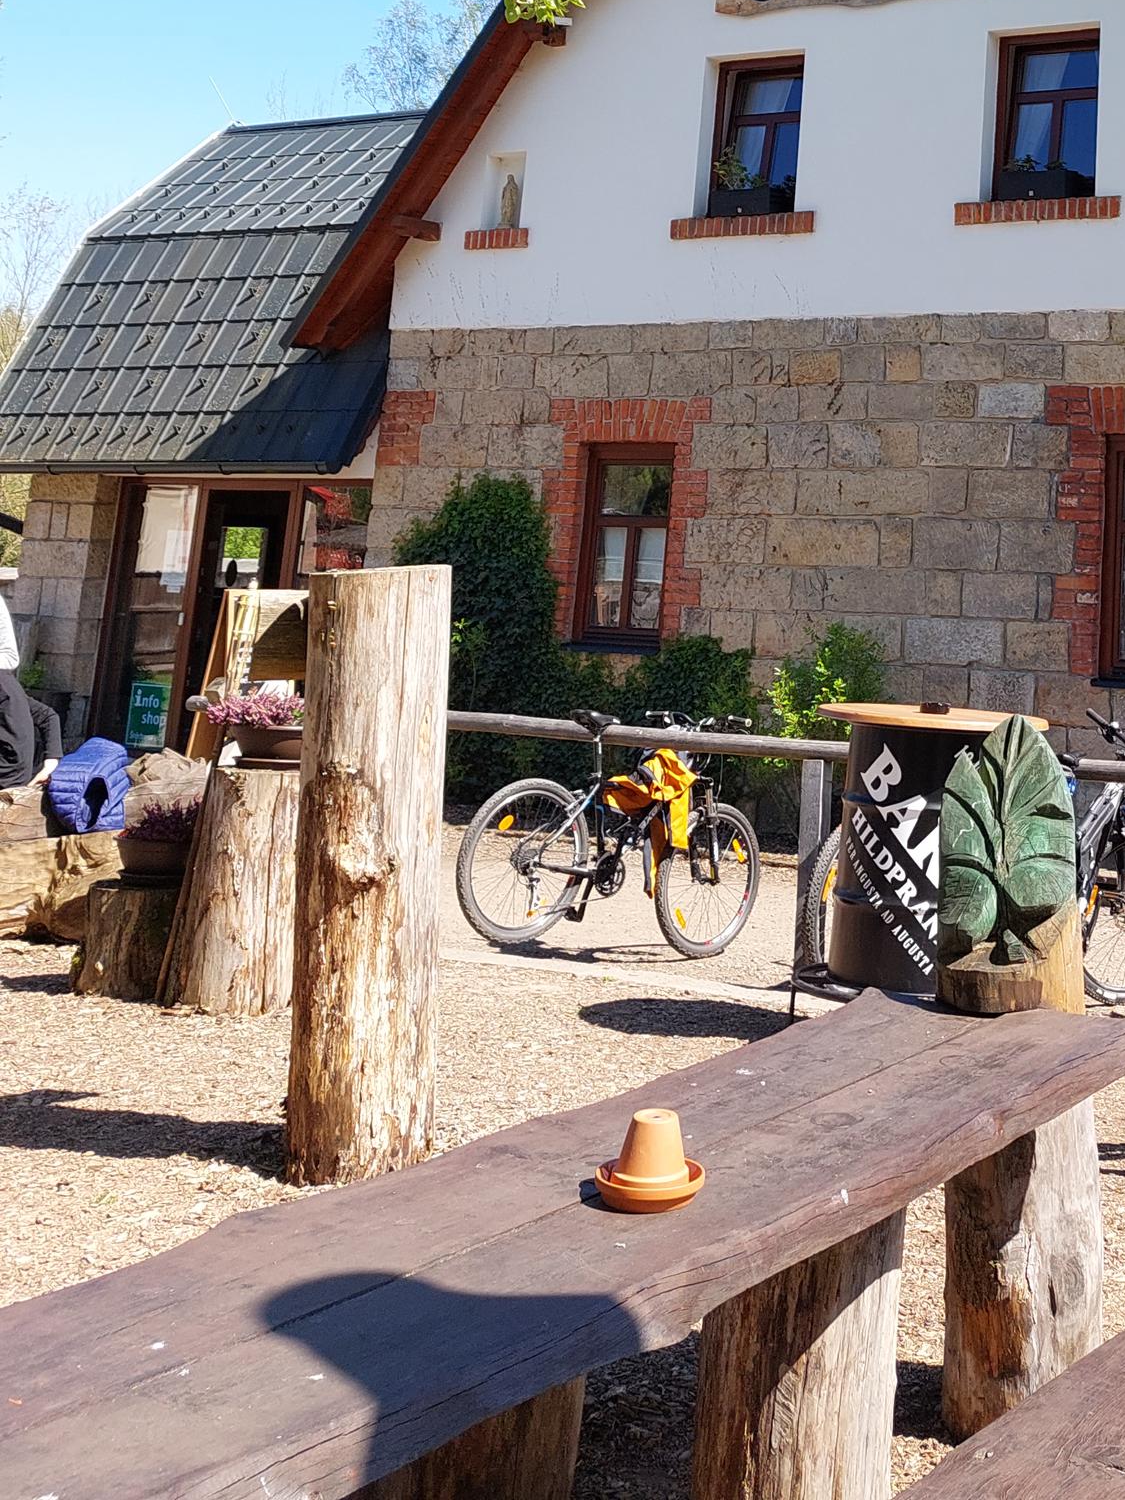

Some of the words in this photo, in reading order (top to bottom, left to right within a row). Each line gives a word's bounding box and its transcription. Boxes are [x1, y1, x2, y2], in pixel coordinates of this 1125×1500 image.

[134, 688, 160, 708] info
[141, 710, 165, 728] shop
[852, 859, 884, 910] ANGUSTA
[880, 909, 896, 924] AD
[891, 924, 935, 976] AUGUSTA
